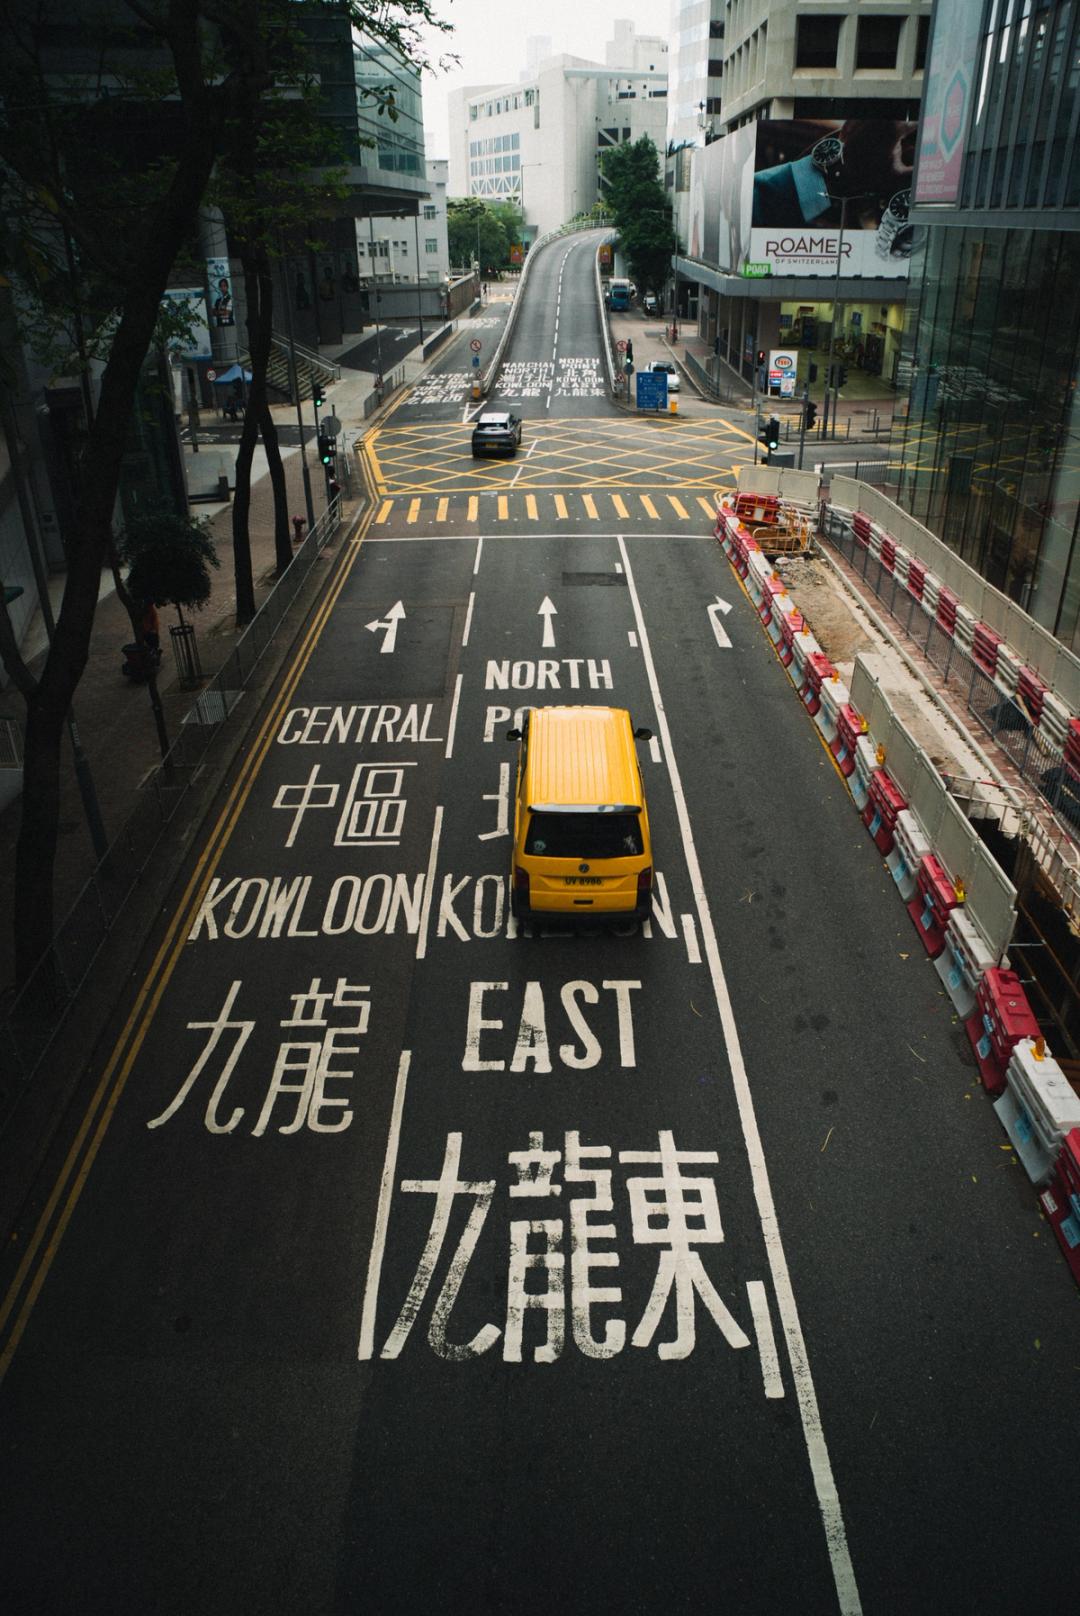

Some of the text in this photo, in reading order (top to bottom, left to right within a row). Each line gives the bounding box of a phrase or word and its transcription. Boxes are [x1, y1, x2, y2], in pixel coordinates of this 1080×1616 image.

[766, 237, 852, 258] ROAMER
[485, 659, 614, 690] NORTH
[277, 704, 444, 744] CENTRAL
[272, 762, 418, 848] 中區
[188, 873, 426, 941] KOWLOON
[147, 978, 371, 1138] 九龍
[462, 980, 642, 1073] EAST
[380, 1130, 751, 1363] 九龍東
